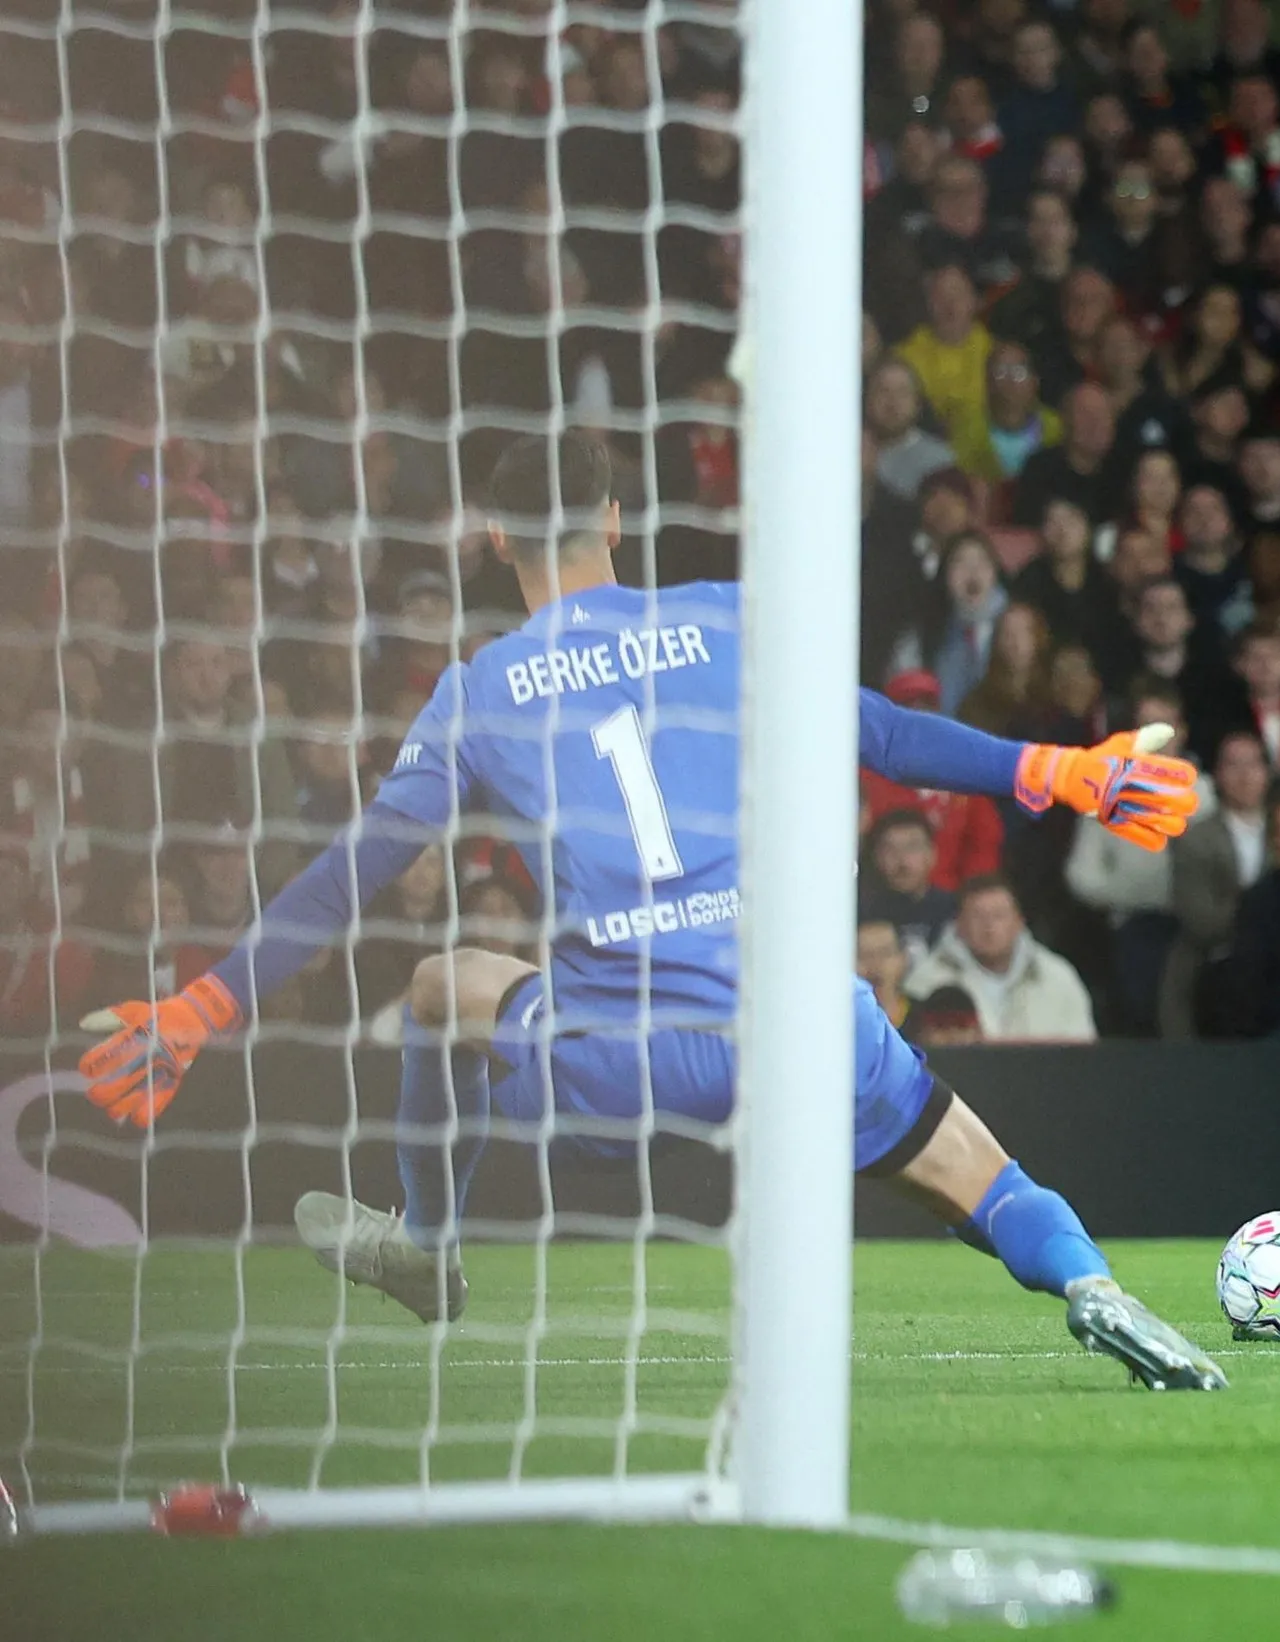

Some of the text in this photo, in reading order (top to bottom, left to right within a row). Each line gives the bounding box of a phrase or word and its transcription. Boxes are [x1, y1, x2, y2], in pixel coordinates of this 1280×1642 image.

[506, 623, 711, 706] BERKE ÖZER
[591, 703, 684, 882] 1
[586, 901, 678, 947] LOSC
